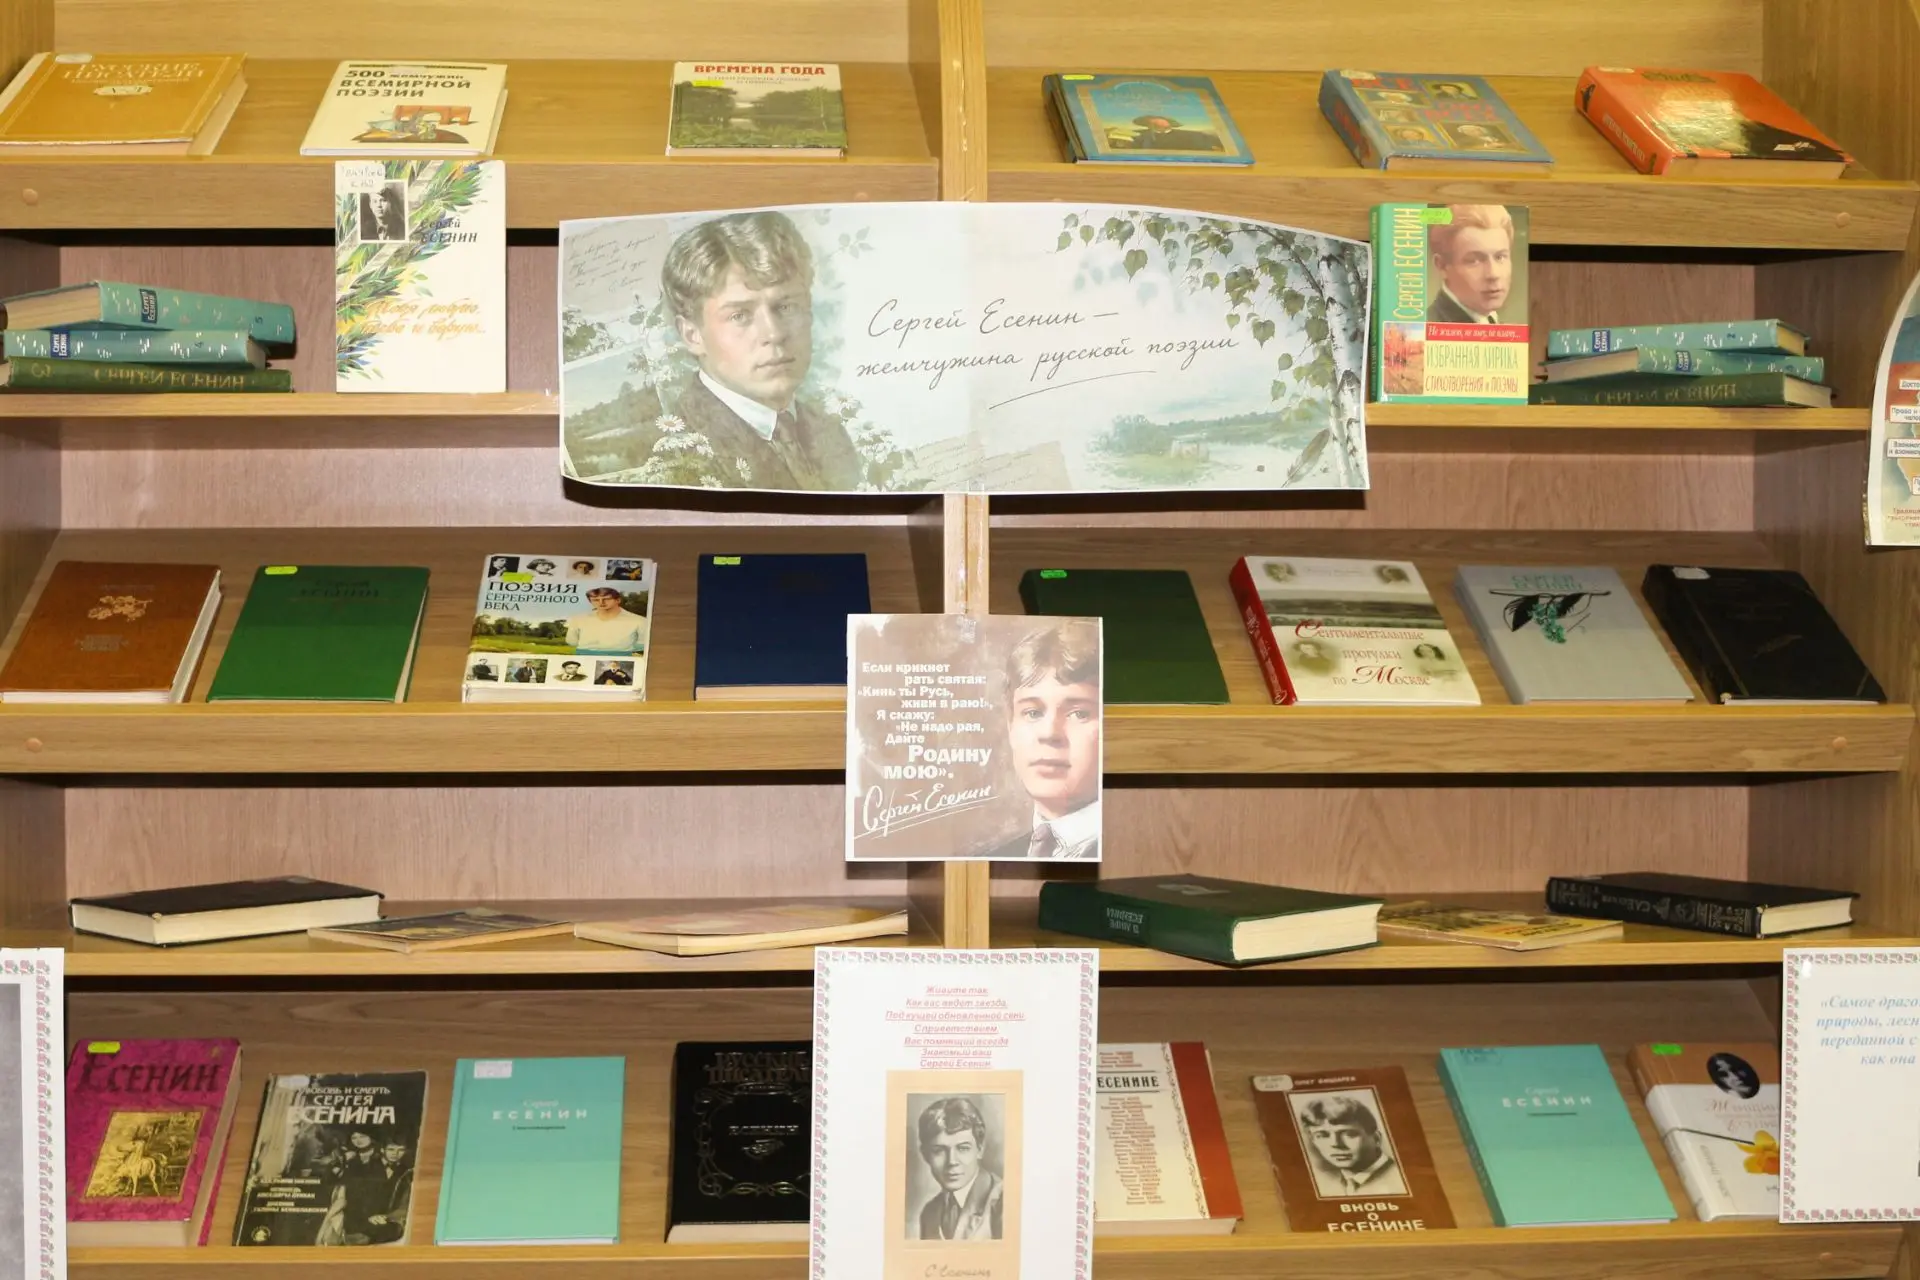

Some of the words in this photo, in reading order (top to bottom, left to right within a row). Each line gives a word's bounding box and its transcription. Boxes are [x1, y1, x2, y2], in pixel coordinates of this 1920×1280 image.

[694, 65, 775, 75] ВРЕМЕНА
[780, 66, 826, 75] ГОДА
[340, 79, 471, 88] ВСЕМИРНОЙ
[336, 89, 424, 97] ПОЭЗИИ
[421, 232, 477, 243] ЕСЕНИН
[1393, 208, 1424, 268] ЕСЕНИН
[869, 298, 966, 349] Сергей
[980, 298, 1085, 334] Есенин
[1427, 344, 1480, 369] ИЗБРАННАЯ
[856, 353, 1023, 390] жемчужина
[1031, 337, 1132, 382] русской
[1147, 337, 1239, 370] поэзии
[1425, 375, 1484, 393] СТИХОТВОРЕНИЯ
[1491, 376, 1519, 393] ПОЭМЫ
[489, 581, 577, 593] ПОЭЗИЯ
[486, 593, 579, 604] СЕРЕБРЯНОГО
[484, 602, 520, 611] ВЕКА
[1295, 619, 1425, 640] Сентиментальные
[1342, 649, 1402, 664] прогулки
[861, 662, 892, 673] Если
[896, 663, 950, 674] крикнет
[905, 675, 934, 686] рать
[937, 675, 987, 685] святая:
[1332, 676, 1347, 685] по
[1352, 665, 1431, 685] Москве
[898, 687, 916, 697] ты
[919, 686, 954, 699] Русь,
[901, 699, 937, 709] живи
[940, 699, 948, 708] в
[876, 709, 886, 720] Я
[889, 711, 935, 723] скажу:
[921, 722, 954, 733] надо
[957, 722, 984, 734] рая,
[885, 732, 925, 745] Дайте
[925, 783, 992, 811] Есенин
[926, 985, 966, 994] Живите
[906, 998, 922, 1007] Как
[1879, 995, 1920, 1011] драго
[885, 1010, 904, 1019] Под
[914, 1024, 921, 1032] С
[1816, 1016, 1882, 1030] природы,
[904, 1037, 922, 1045] Вас
[1820, 1034, 1905, 1049] переданной
[1909, 1036, 1918, 1045] с
[1861, 1056, 1885, 1064] как
[1890, 1056, 1916, 1064] она
[77, 1052, 221, 1094] ЕСЕНИН
[1097, 1075, 1160, 1088] ЕСЕНИНЕ
[313, 1095, 374, 1106] СЕРГЕЯ
[1502, 1097, 1592, 1108] ЕСЕНИН
[288, 1106, 396, 1124] СЕНИНА
[492, 1109, 587, 1120] ЕСЕНИН
[1340, 1202, 1399, 1213] ВНОВЬ
[1367, 1212, 1379, 1221] О
[1327, 1220, 1426, 1233] ЕСЕНИНЕ
